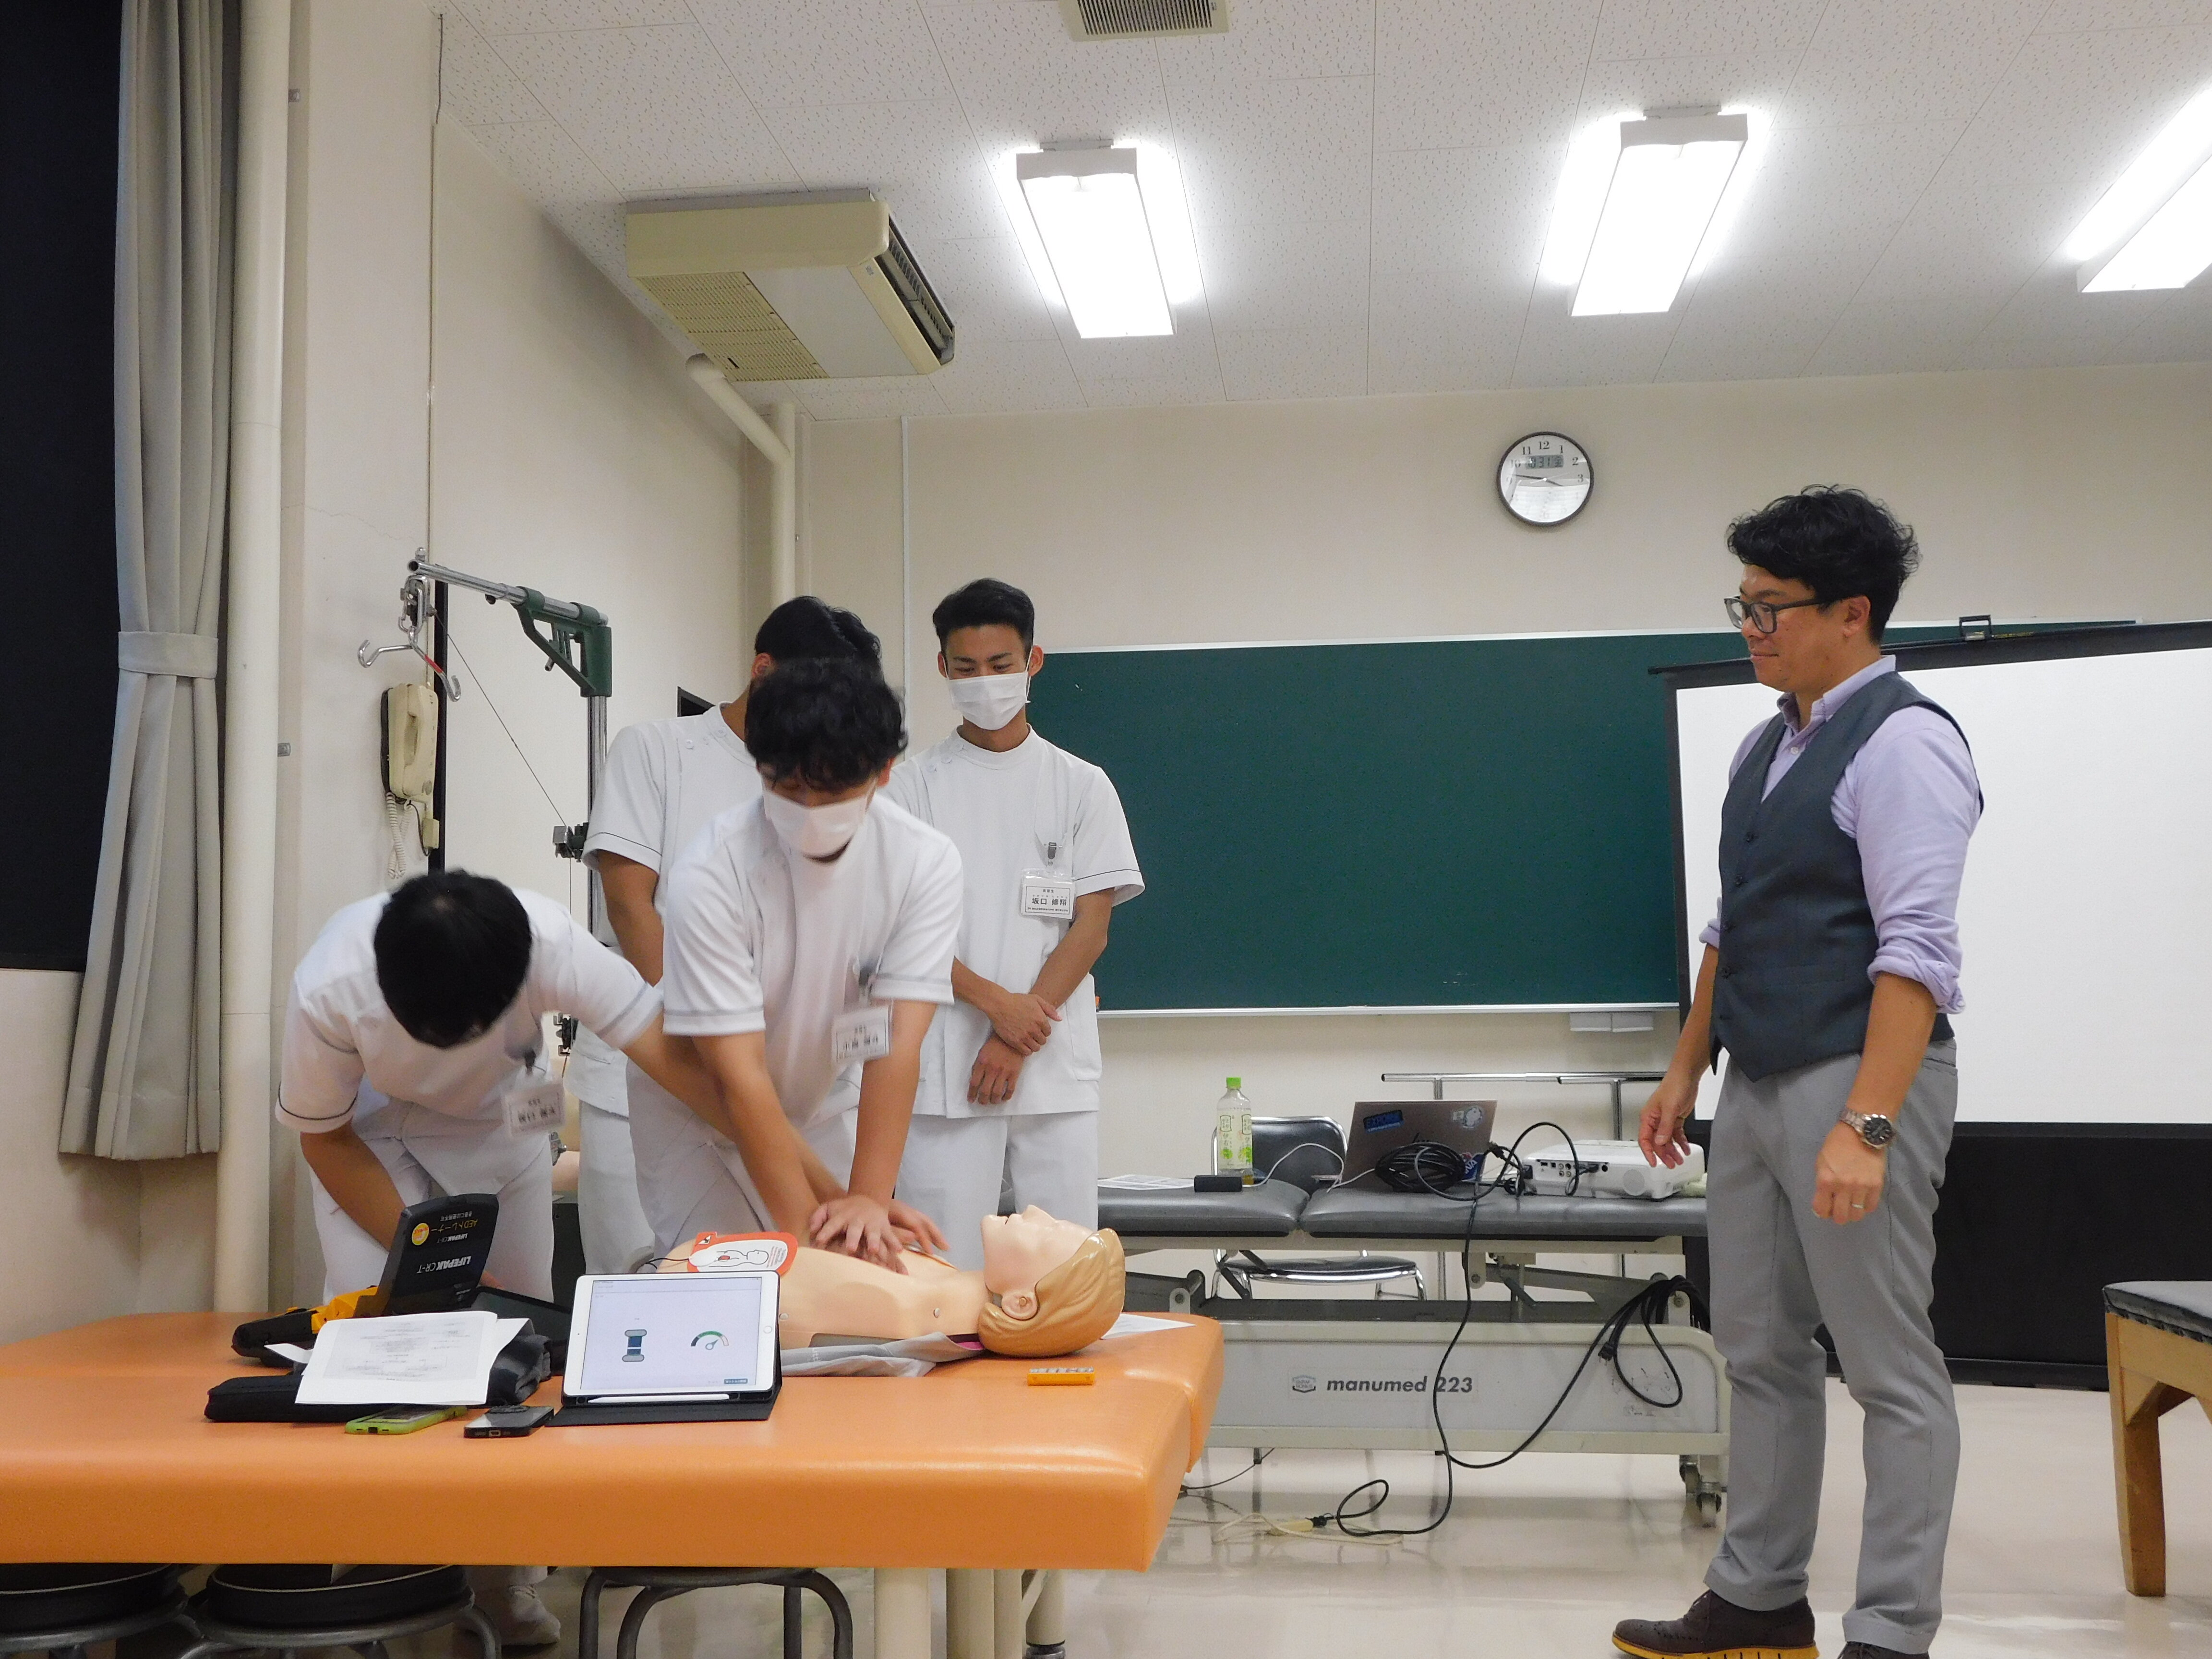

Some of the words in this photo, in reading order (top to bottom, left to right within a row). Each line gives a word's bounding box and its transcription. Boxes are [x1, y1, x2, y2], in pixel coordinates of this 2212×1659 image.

[1538, 441, 1550, 449] 12
[1523, 446, 1531, 455] 11
[1572, 457, 1579, 466] 2
[1577, 474, 1584, 482] 3
[447, 1233, 468, 1242] LIFEPAK
[416, 1262, 436, 1274] CR-T
[435, 1256, 472, 1271] LIFEPAK
[1327, 1376, 1428, 1392] manumed
[1436, 1377, 1473, 1393] 223
